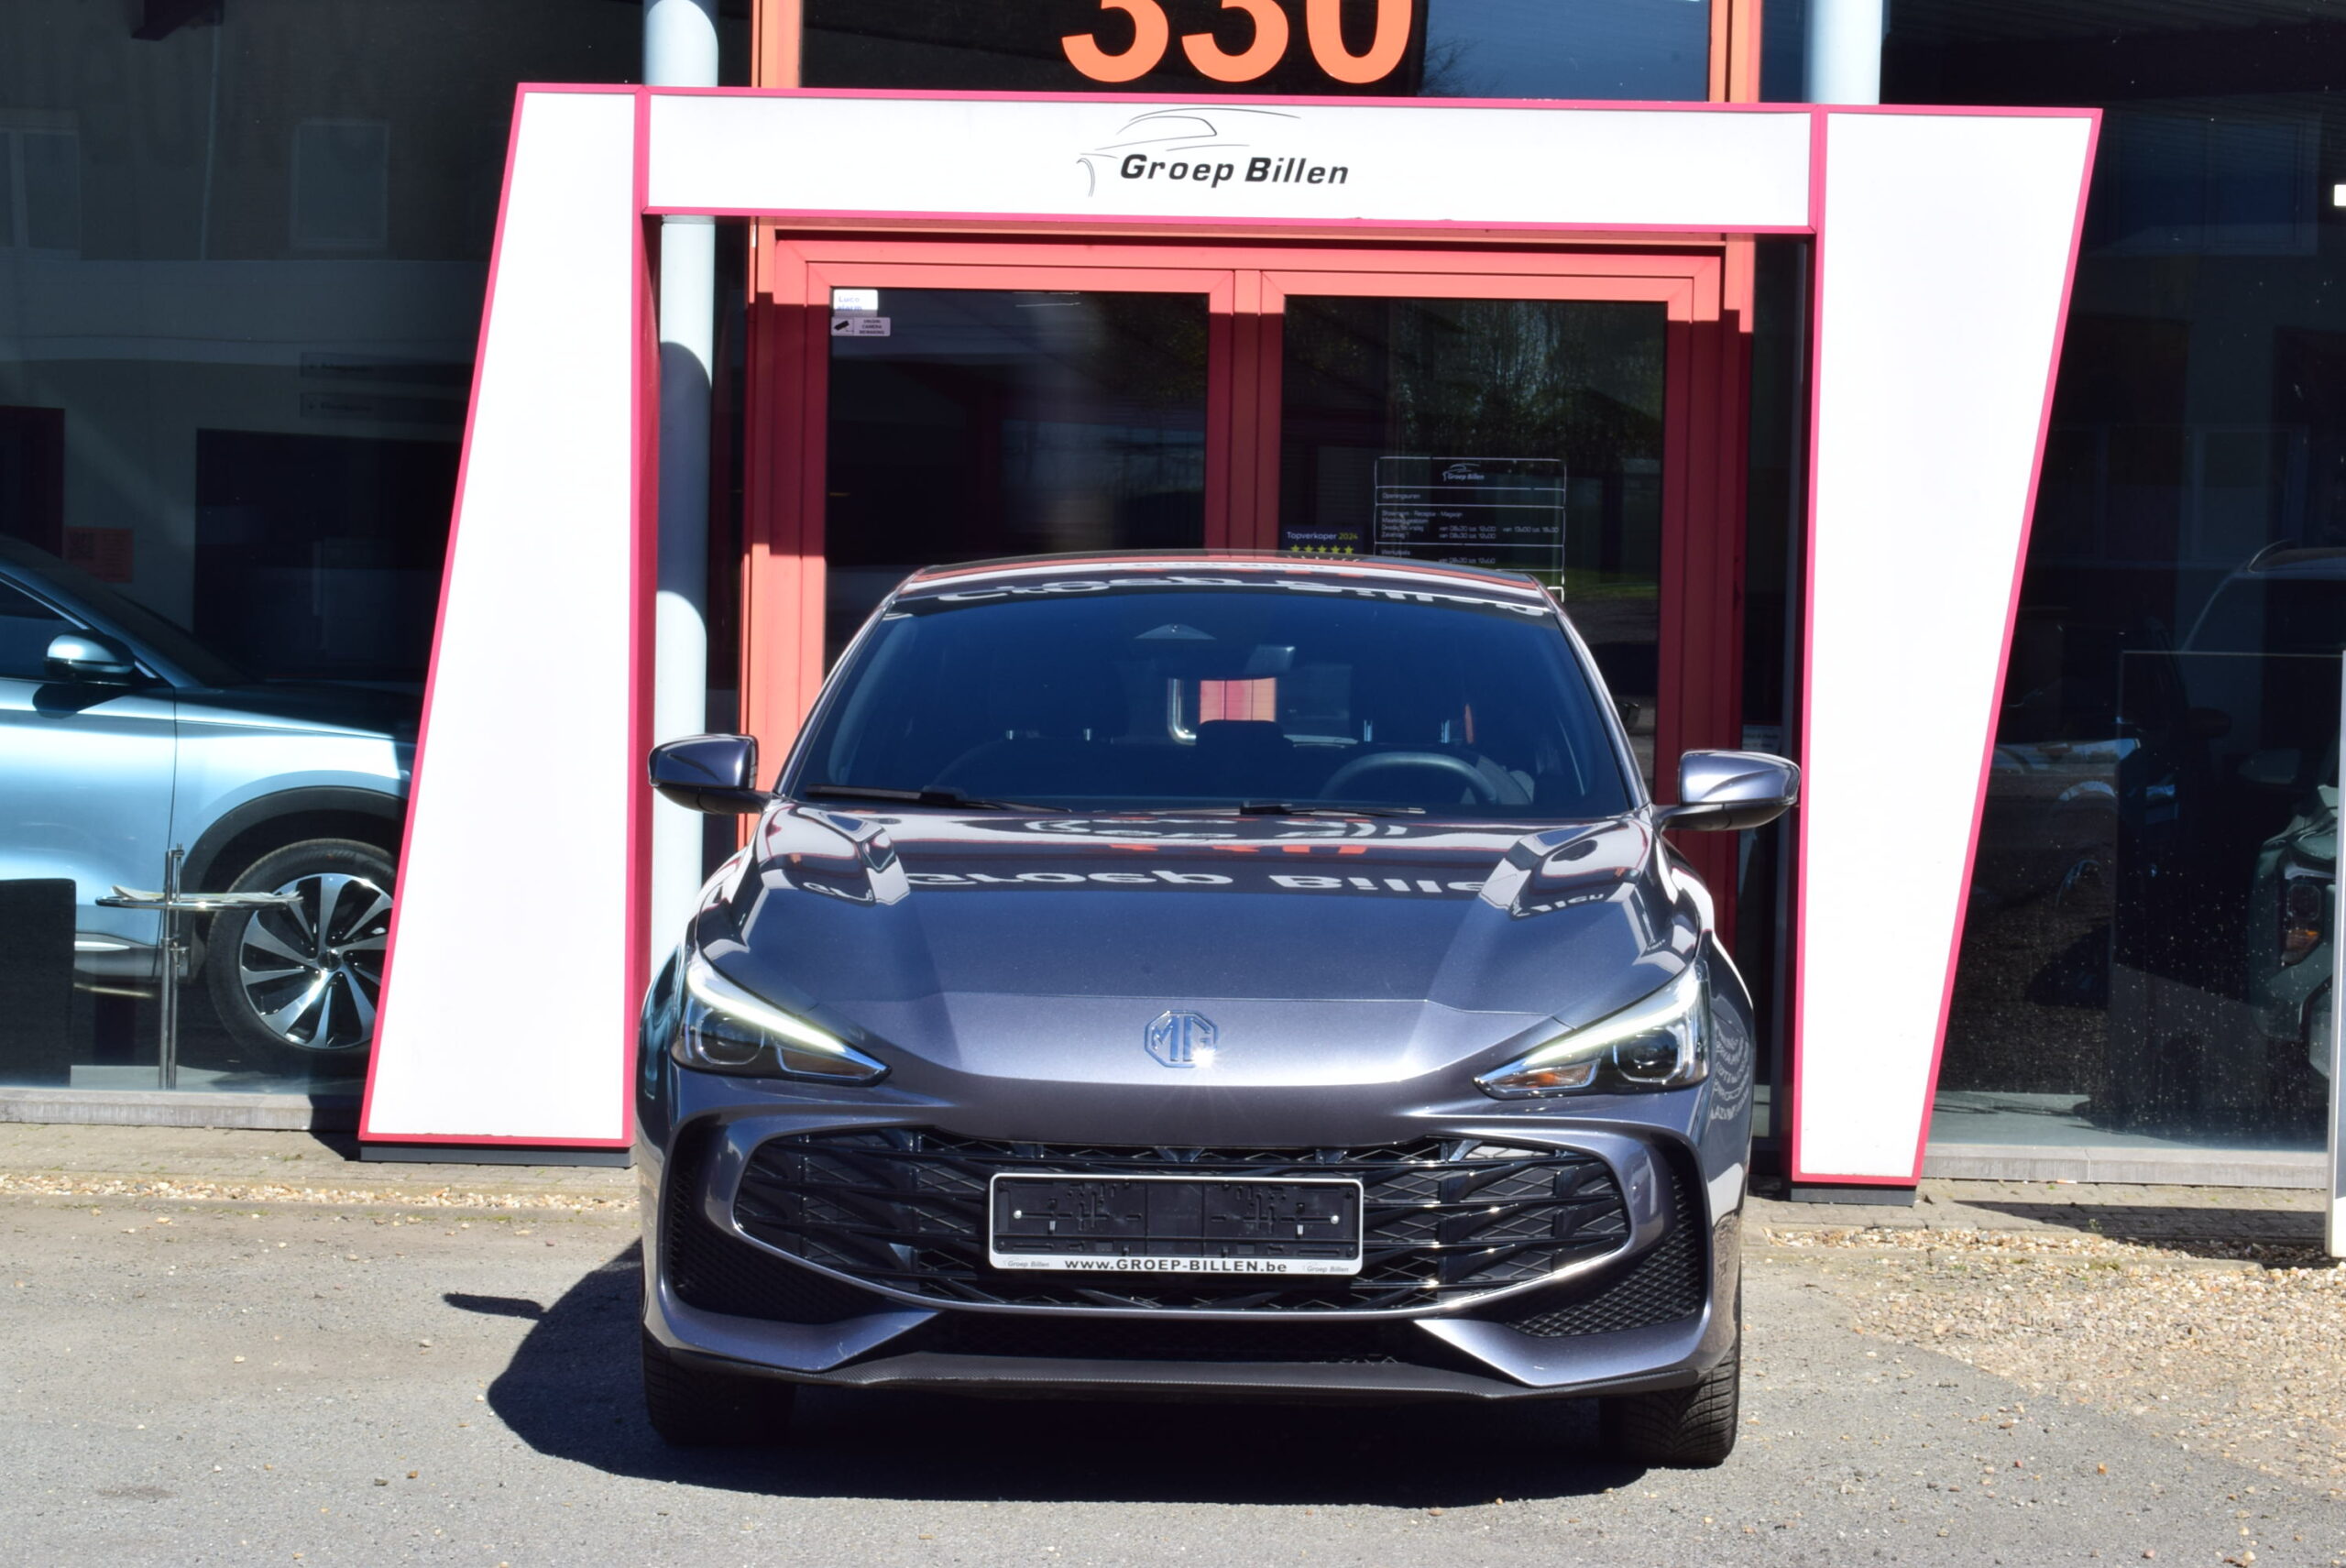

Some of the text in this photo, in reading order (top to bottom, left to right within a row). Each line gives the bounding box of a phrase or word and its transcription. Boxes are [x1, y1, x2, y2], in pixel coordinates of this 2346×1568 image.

[1120, 154, 1349, 188] Groep Billen
[1287, 532, 1337, 541] Topverkoper
[1149, 1014, 1213, 1064] MG
[1008, 1260, 1029, 1268] Groep
[1064, 1259, 1288, 1273] www.GROEP-BILLEN.be
[1307, 1265, 1328, 1274] Groep
